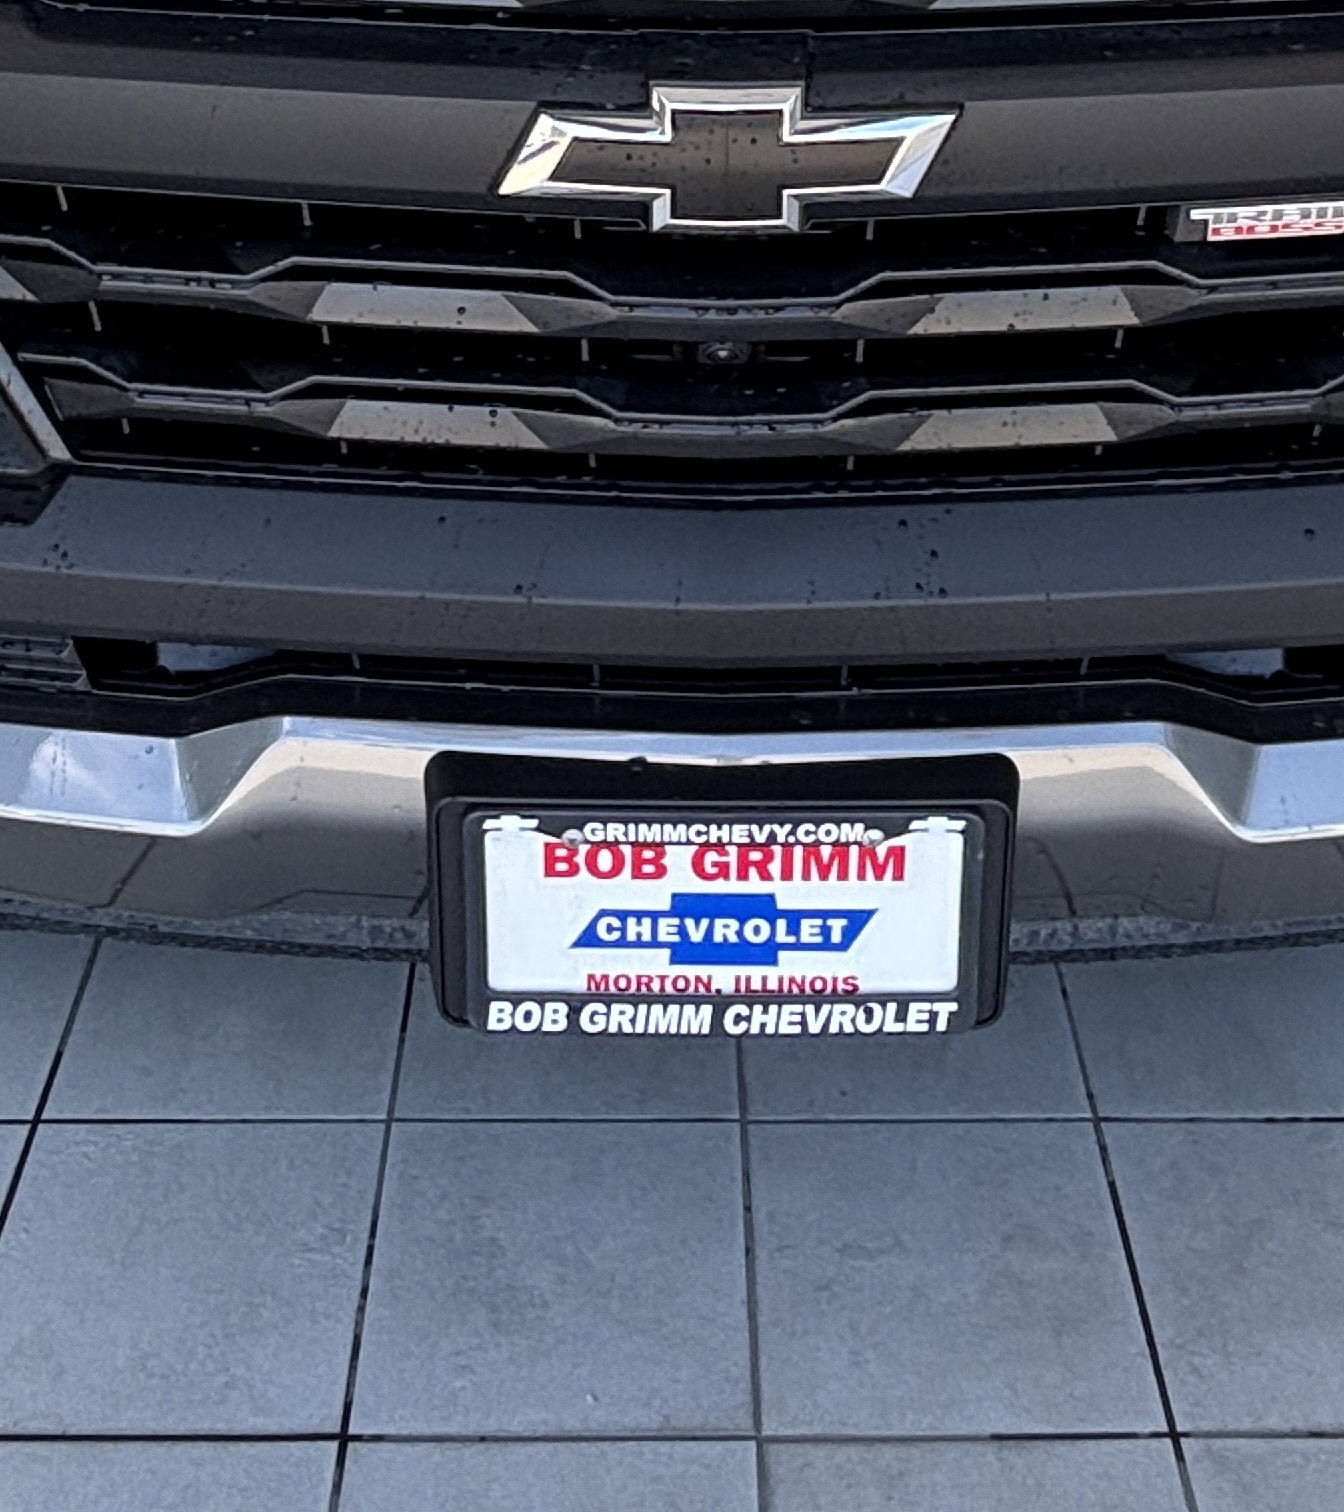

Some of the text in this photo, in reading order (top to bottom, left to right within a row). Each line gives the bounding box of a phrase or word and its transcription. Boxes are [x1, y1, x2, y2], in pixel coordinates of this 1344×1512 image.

[582, 822, 865, 844] GRIMMCHEVY.COM
[543, 843, 906, 881] BOB GRIMM
[596, 916, 848, 944] CHEVROLET
[735, 974, 860, 995] ILLINOIS
[486, 1000, 959, 1035] BOB GRIMM CHEVROLET
